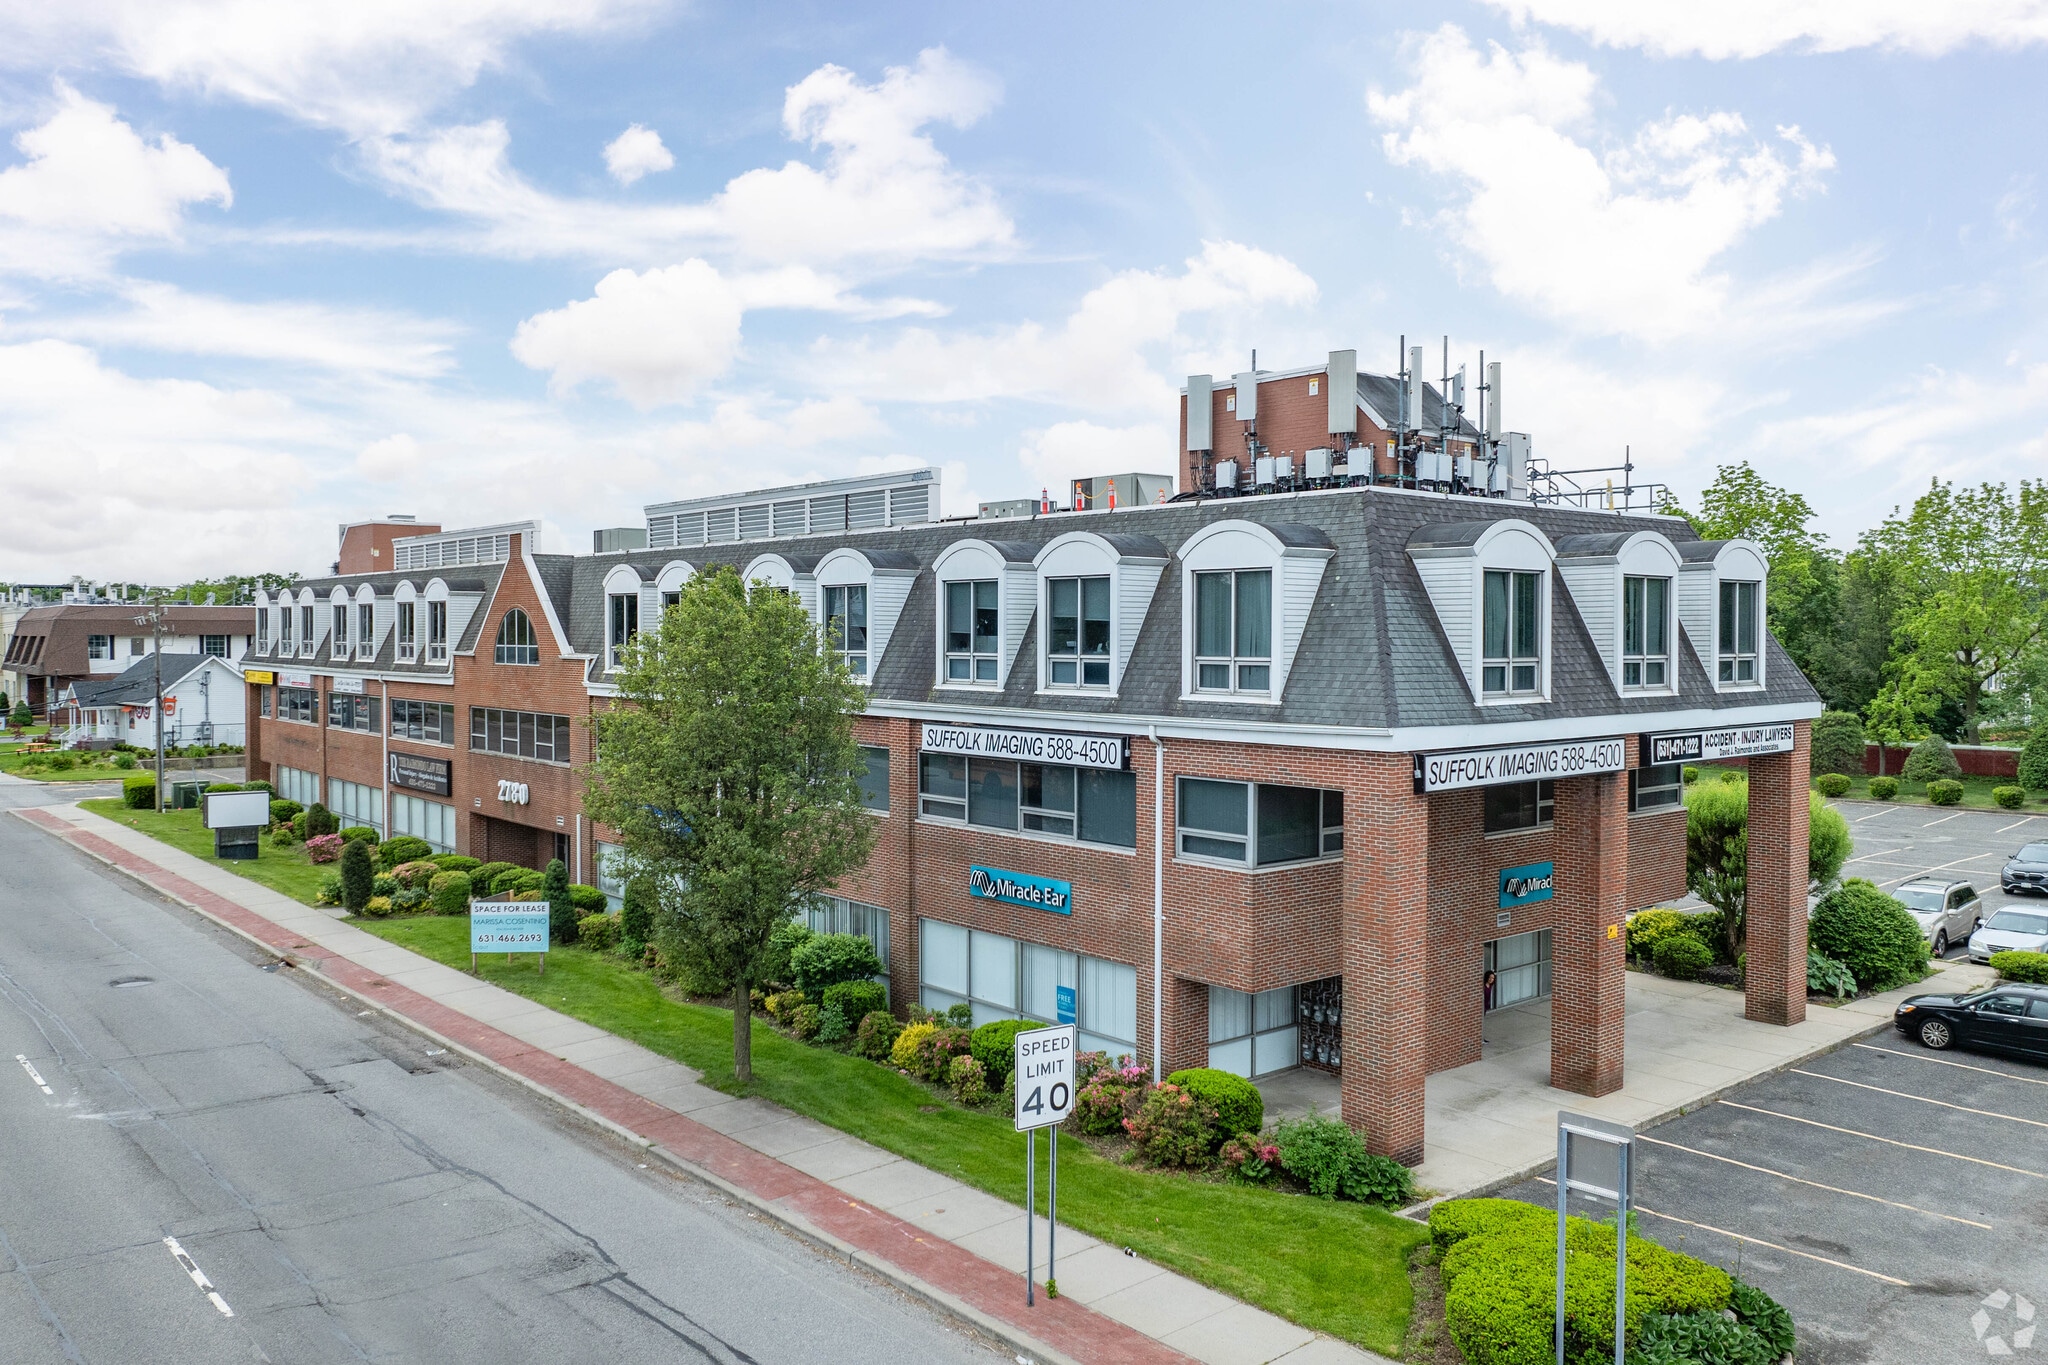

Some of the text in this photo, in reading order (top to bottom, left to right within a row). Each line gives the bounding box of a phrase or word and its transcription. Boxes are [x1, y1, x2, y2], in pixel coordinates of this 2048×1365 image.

[926, 728, 1117, 765] SUFFOLK IMAGING 588-4500
[1704, 732, 1737, 748] ACCIDENT
[1741, 729, 1764, 744] INJURY
[1764, 726, 1792, 741] LAWYERS
[1428, 743, 1621, 786] SUFFOLK IMAGING 588-4500
[497, 779, 529, 805] 2780
[474, 905, 501, 913] SPACE
[503, 905, 520, 913] FOR
[505, 917, 547, 925] COSENTINO
[478, 933, 542, 943] 631.466.2693
[1057, 993, 1071, 1004] FREE
[1021, 1036, 1070, 1057] SPEED
[1026, 1059, 1065, 1079] LIMIT
[1021, 1081, 1069, 1116] 40
